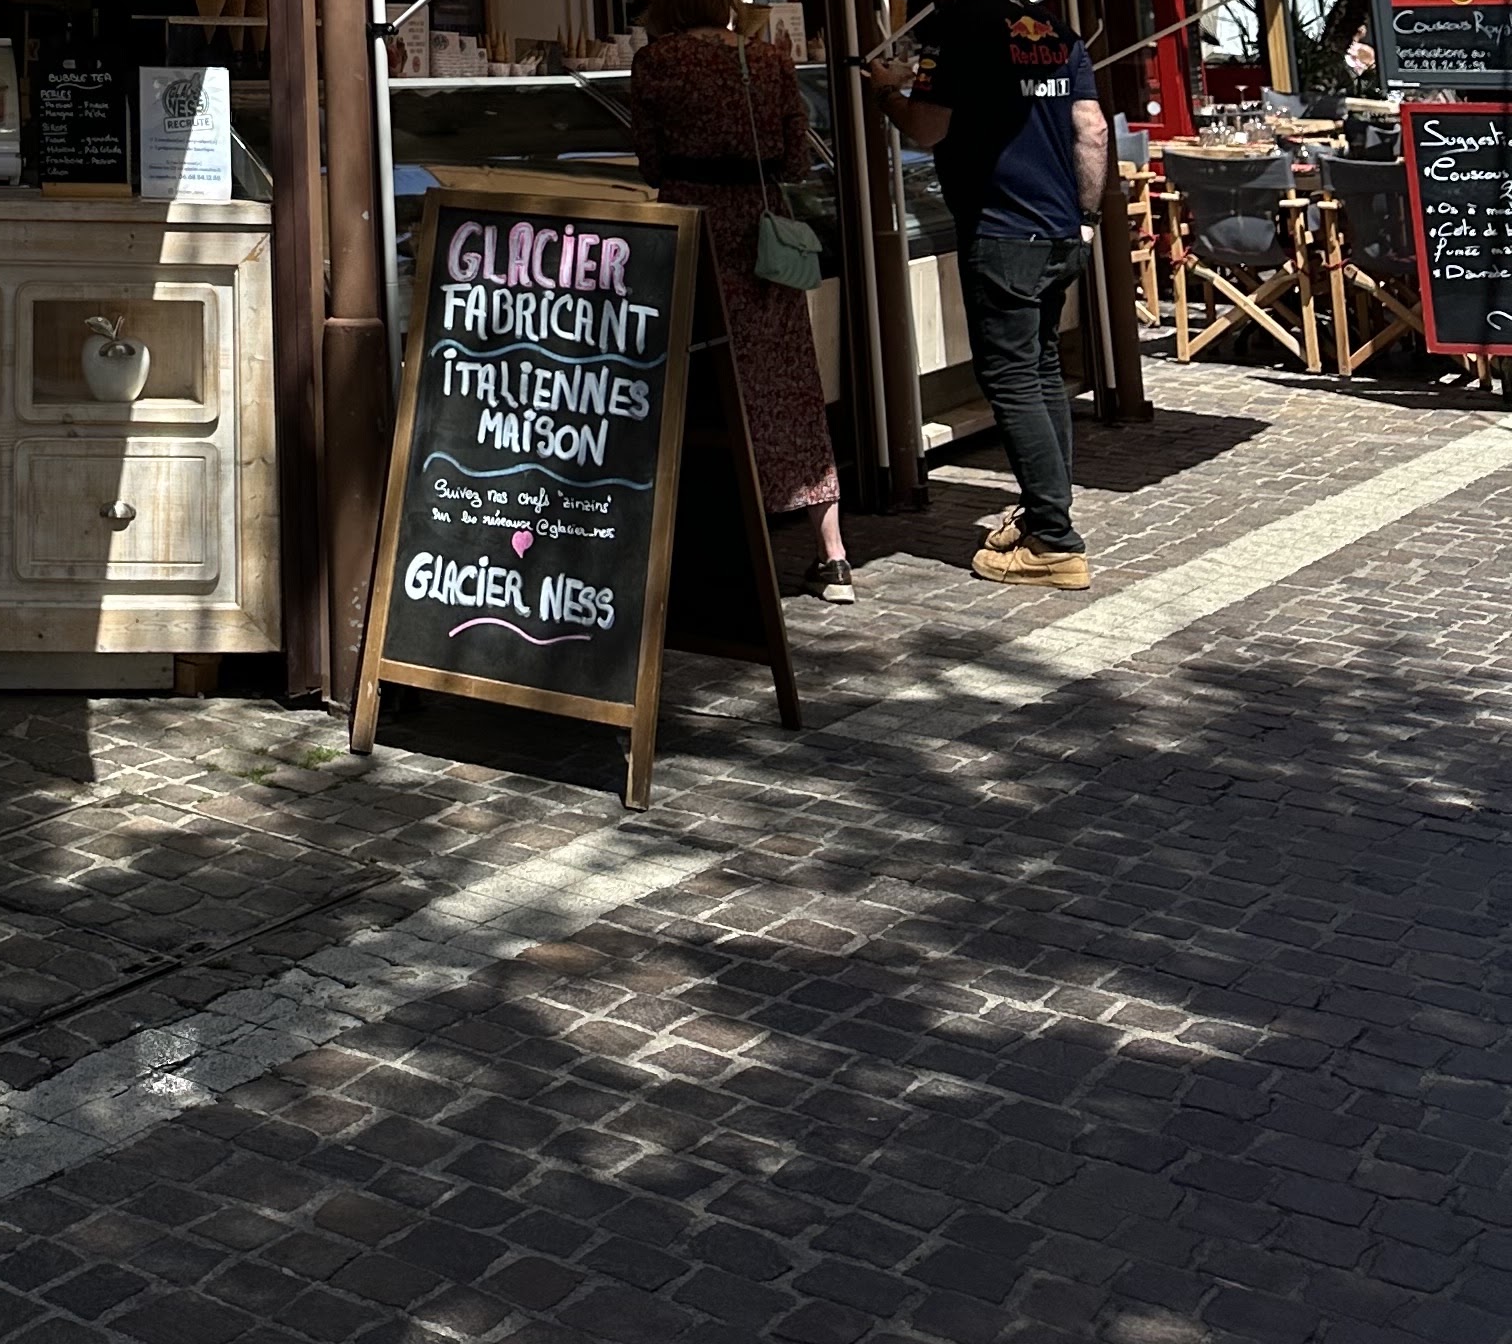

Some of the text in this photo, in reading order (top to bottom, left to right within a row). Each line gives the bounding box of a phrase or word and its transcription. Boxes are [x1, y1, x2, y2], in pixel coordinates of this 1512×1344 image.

[1010, 44, 1068, 65] Red Bull
[48, 72, 112, 83] BUBBLE TEA
[167, 117, 211, 129] RECRUTE
[434, 479, 483, 508] Suivez
[487, 489, 509, 505] nos
[539, 573, 616, 630] NESS
